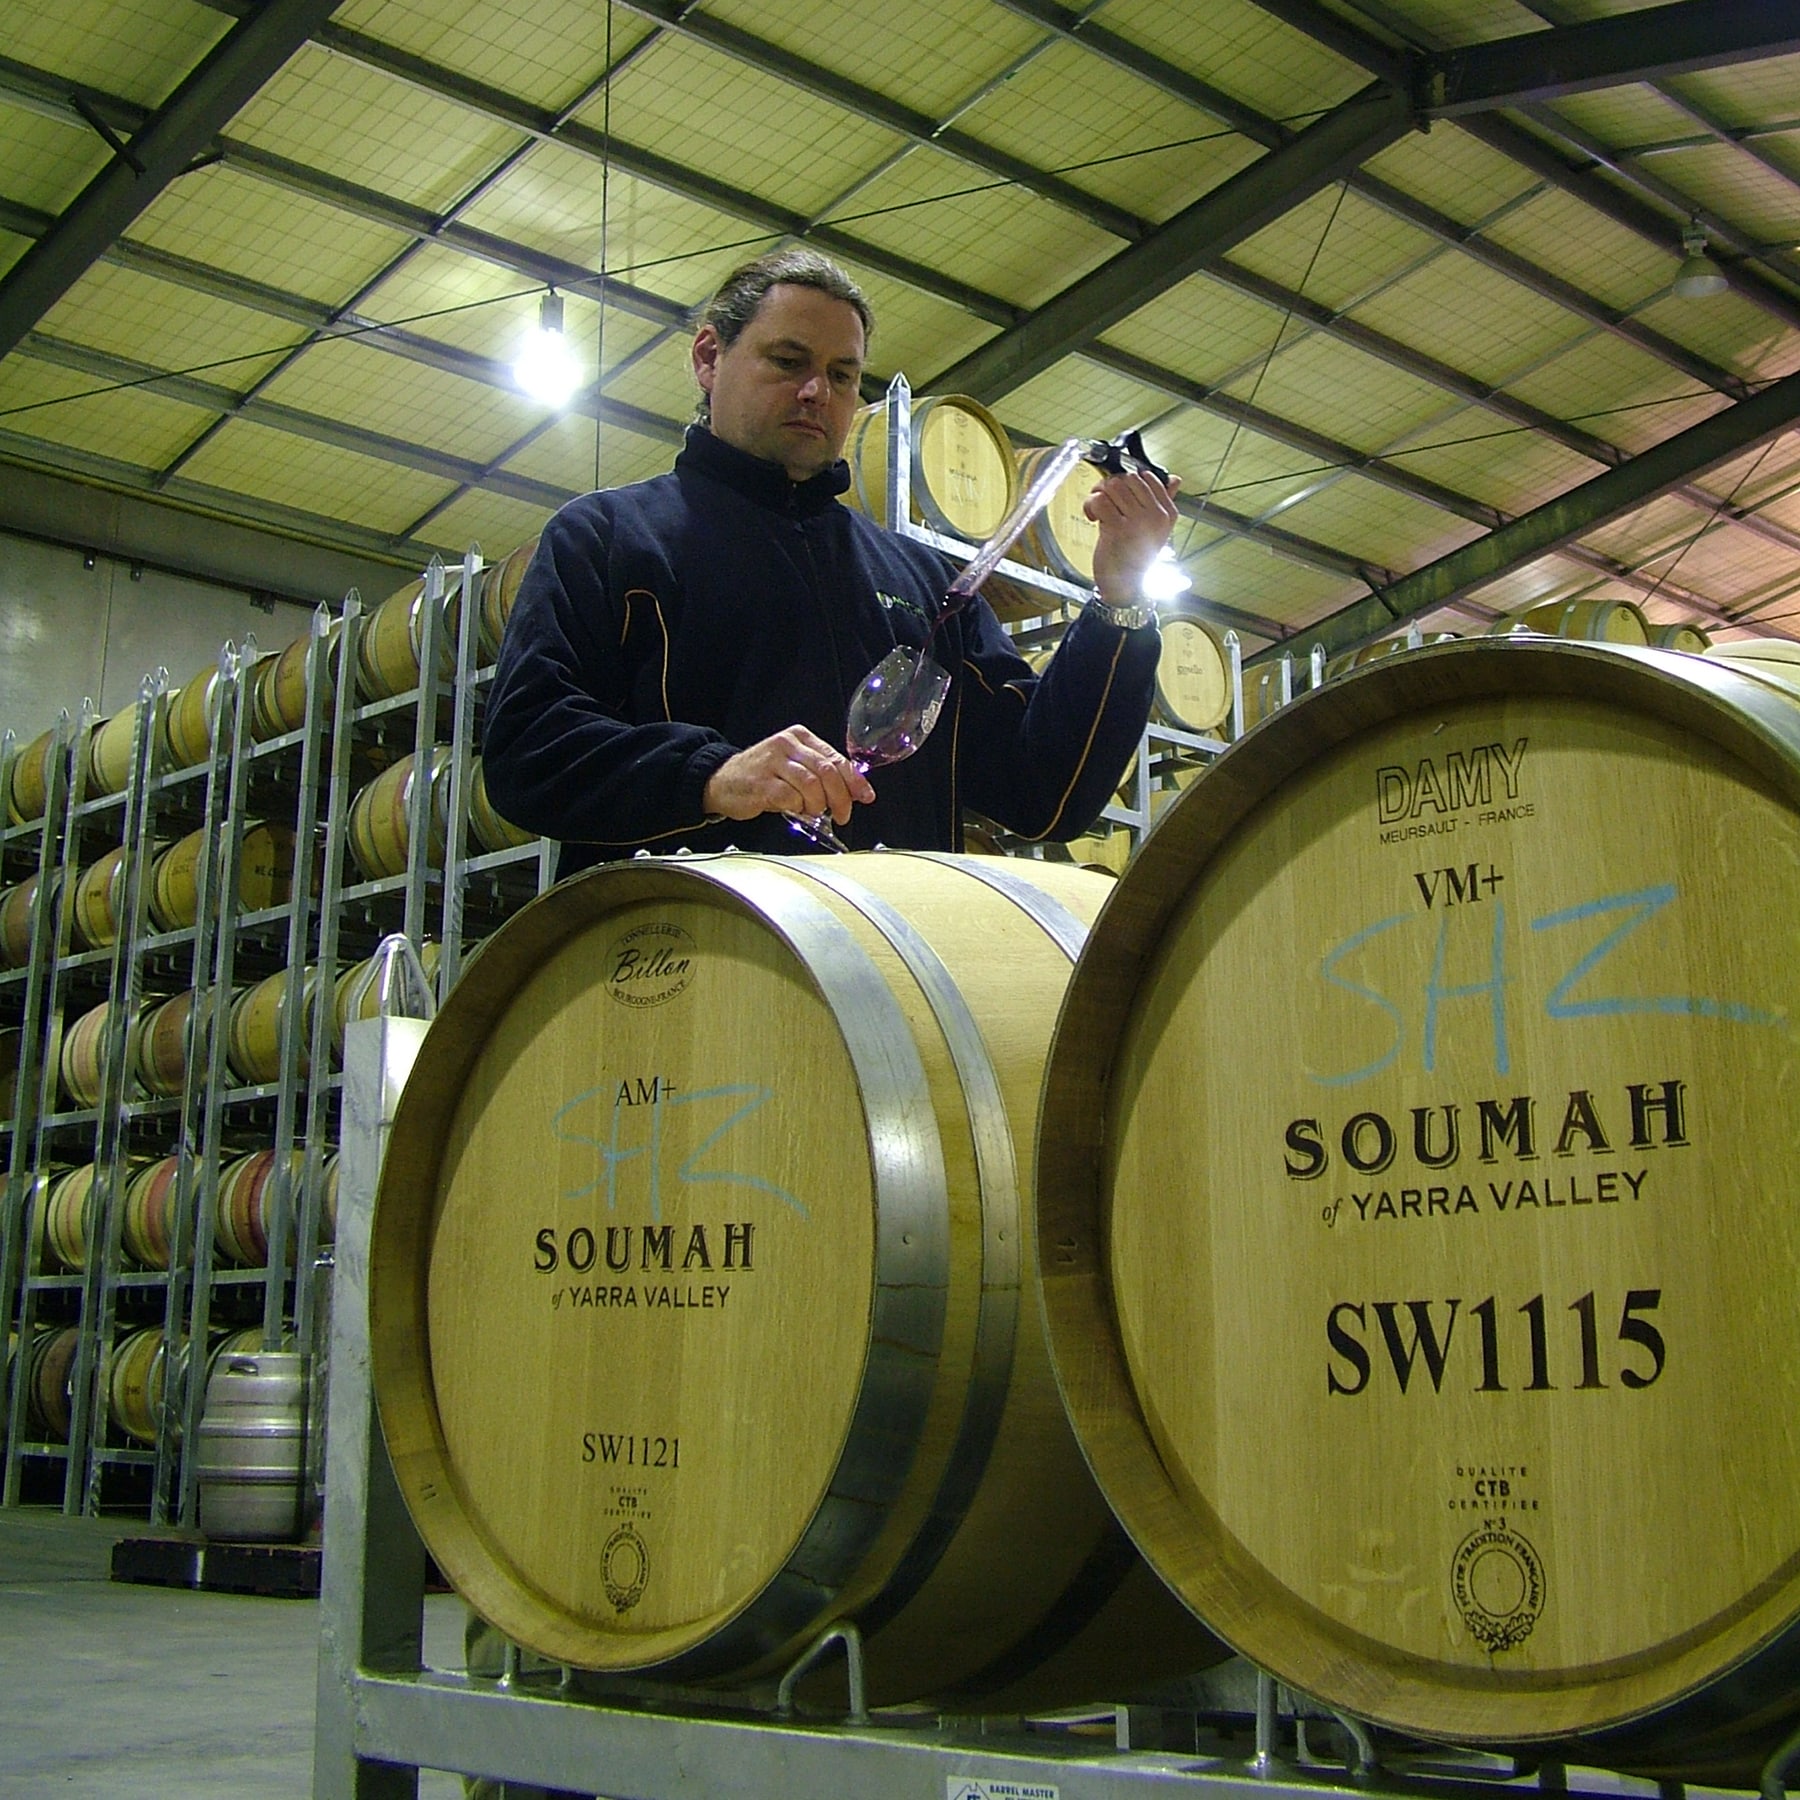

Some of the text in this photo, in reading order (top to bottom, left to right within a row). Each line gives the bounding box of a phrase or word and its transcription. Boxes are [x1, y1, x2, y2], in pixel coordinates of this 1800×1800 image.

[1376, 737, 1529, 826] DAMY
[1379, 817, 1459, 846] MEURSAULT
[1478, 803, 1536, 827] FRANCE
[1413, 862, 1505, 911] VM+
[610, 947, 691, 984] Billon
[1310, 885, 1787, 1088] SHZ
[614, 1076, 677, 1107] AM+
[1284, 1079, 1692, 1182] SOUMAH
[1322, 1169, 1649, 1229] of YARRA VALLEY
[533, 1222, 756, 1275] SOUMAH
[551, 1285, 731, 1310] of YARRA VALLEY
[1327, 1288, 1666, 1396] SW1115
[581, 1432, 681, 1469] SW1121
[618, 1496, 638, 1508] CTB
[1474, 1480, 1511, 1497] CTB
[1022, 1786, 1055, 1799] MASTER
